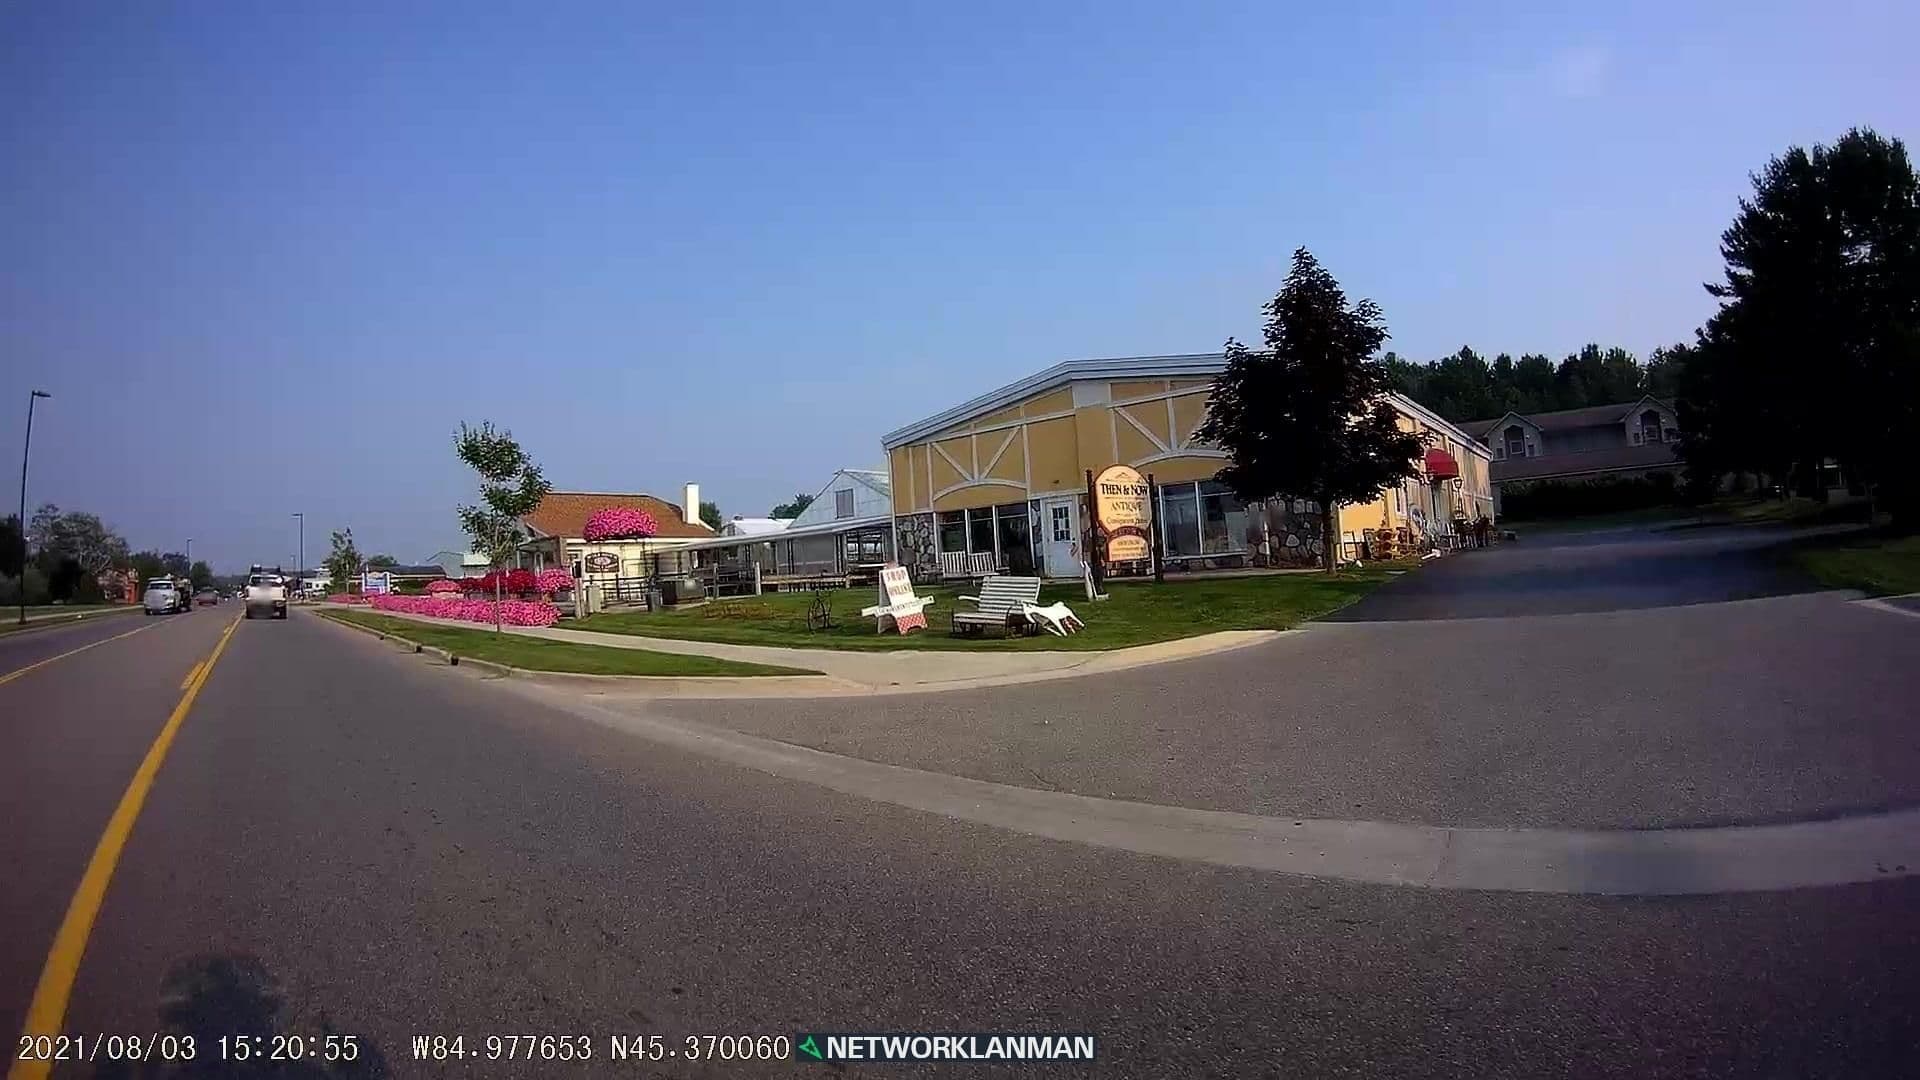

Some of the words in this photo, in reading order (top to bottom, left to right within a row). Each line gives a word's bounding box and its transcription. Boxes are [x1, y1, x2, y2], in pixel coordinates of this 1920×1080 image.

[1101, 483, 1121, 495] THEN
[1123, 485, 1130, 495] &
[1130, 484, 1148, 495] NOW
